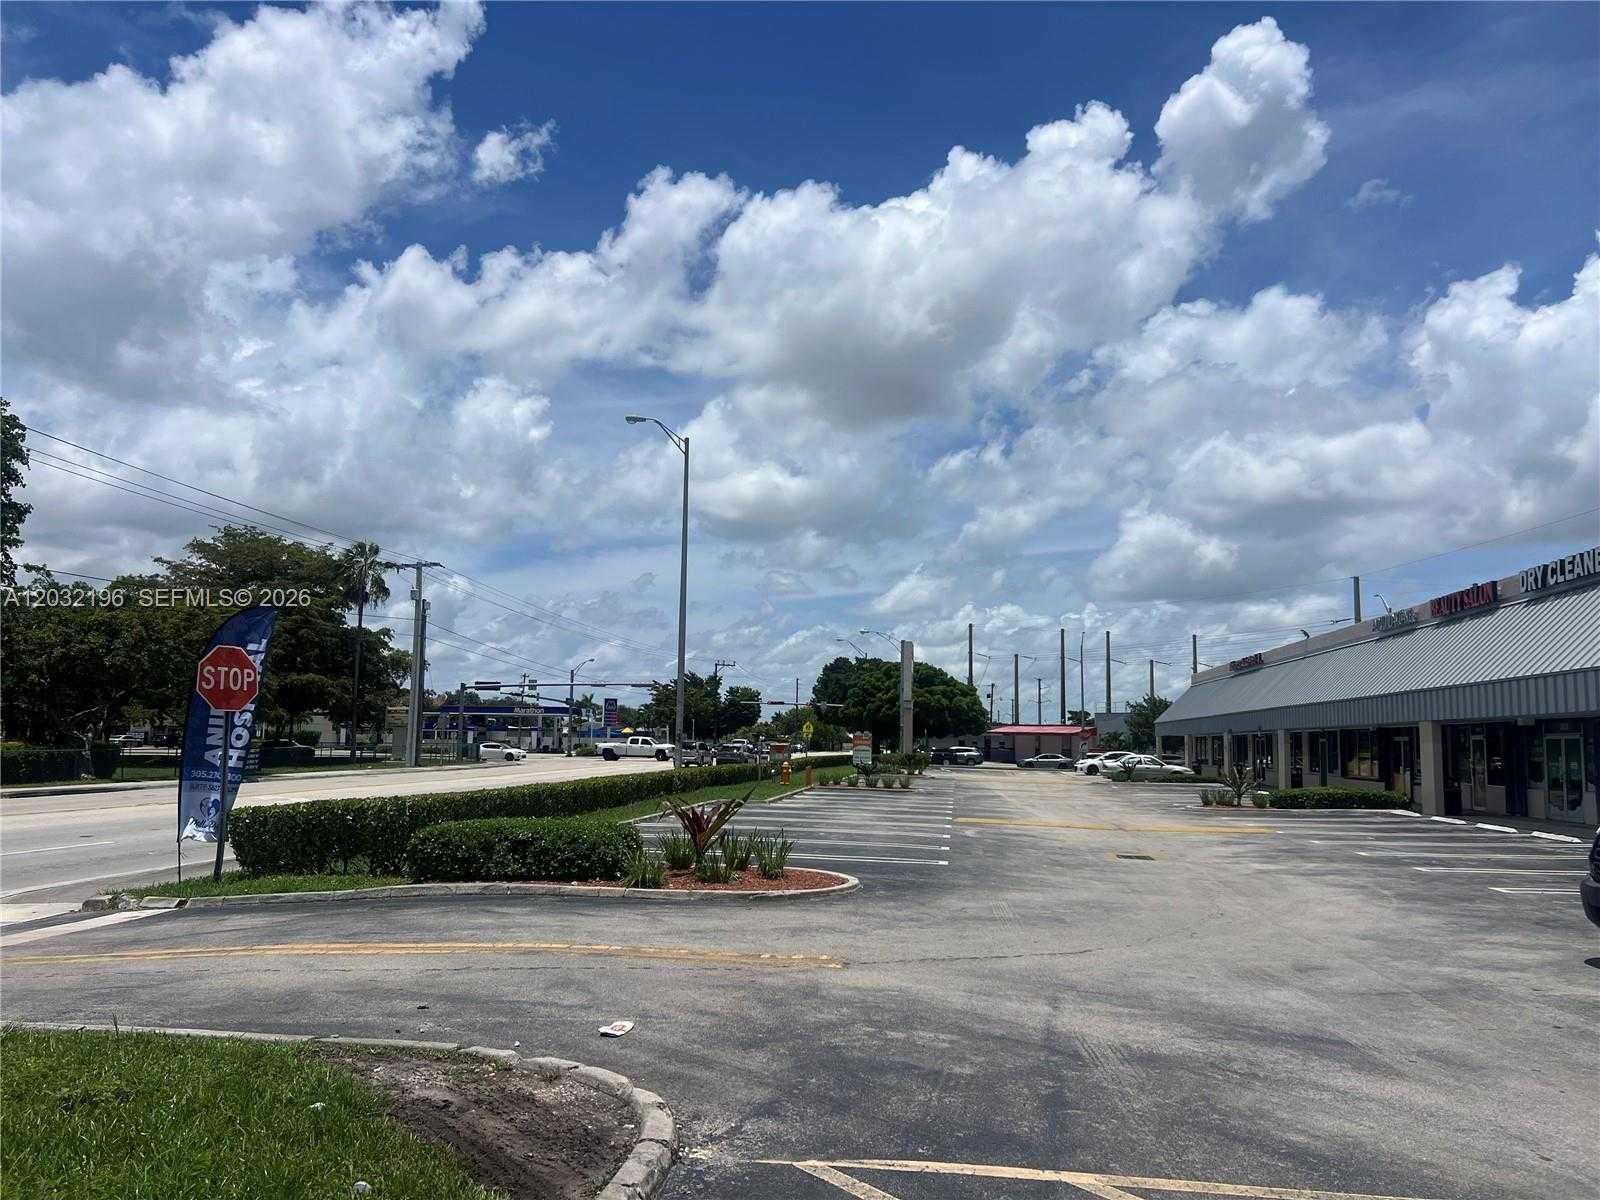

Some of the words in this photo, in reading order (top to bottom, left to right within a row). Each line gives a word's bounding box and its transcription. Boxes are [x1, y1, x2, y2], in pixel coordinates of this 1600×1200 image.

[1519, 565, 1544, 593] DRY
[1430, 592, 1464, 617] BEAUTY
[1464, 581, 1496, 608] SALON
[202, 665, 255, 691] STOP
[513, 706, 544, 714] Marathon
